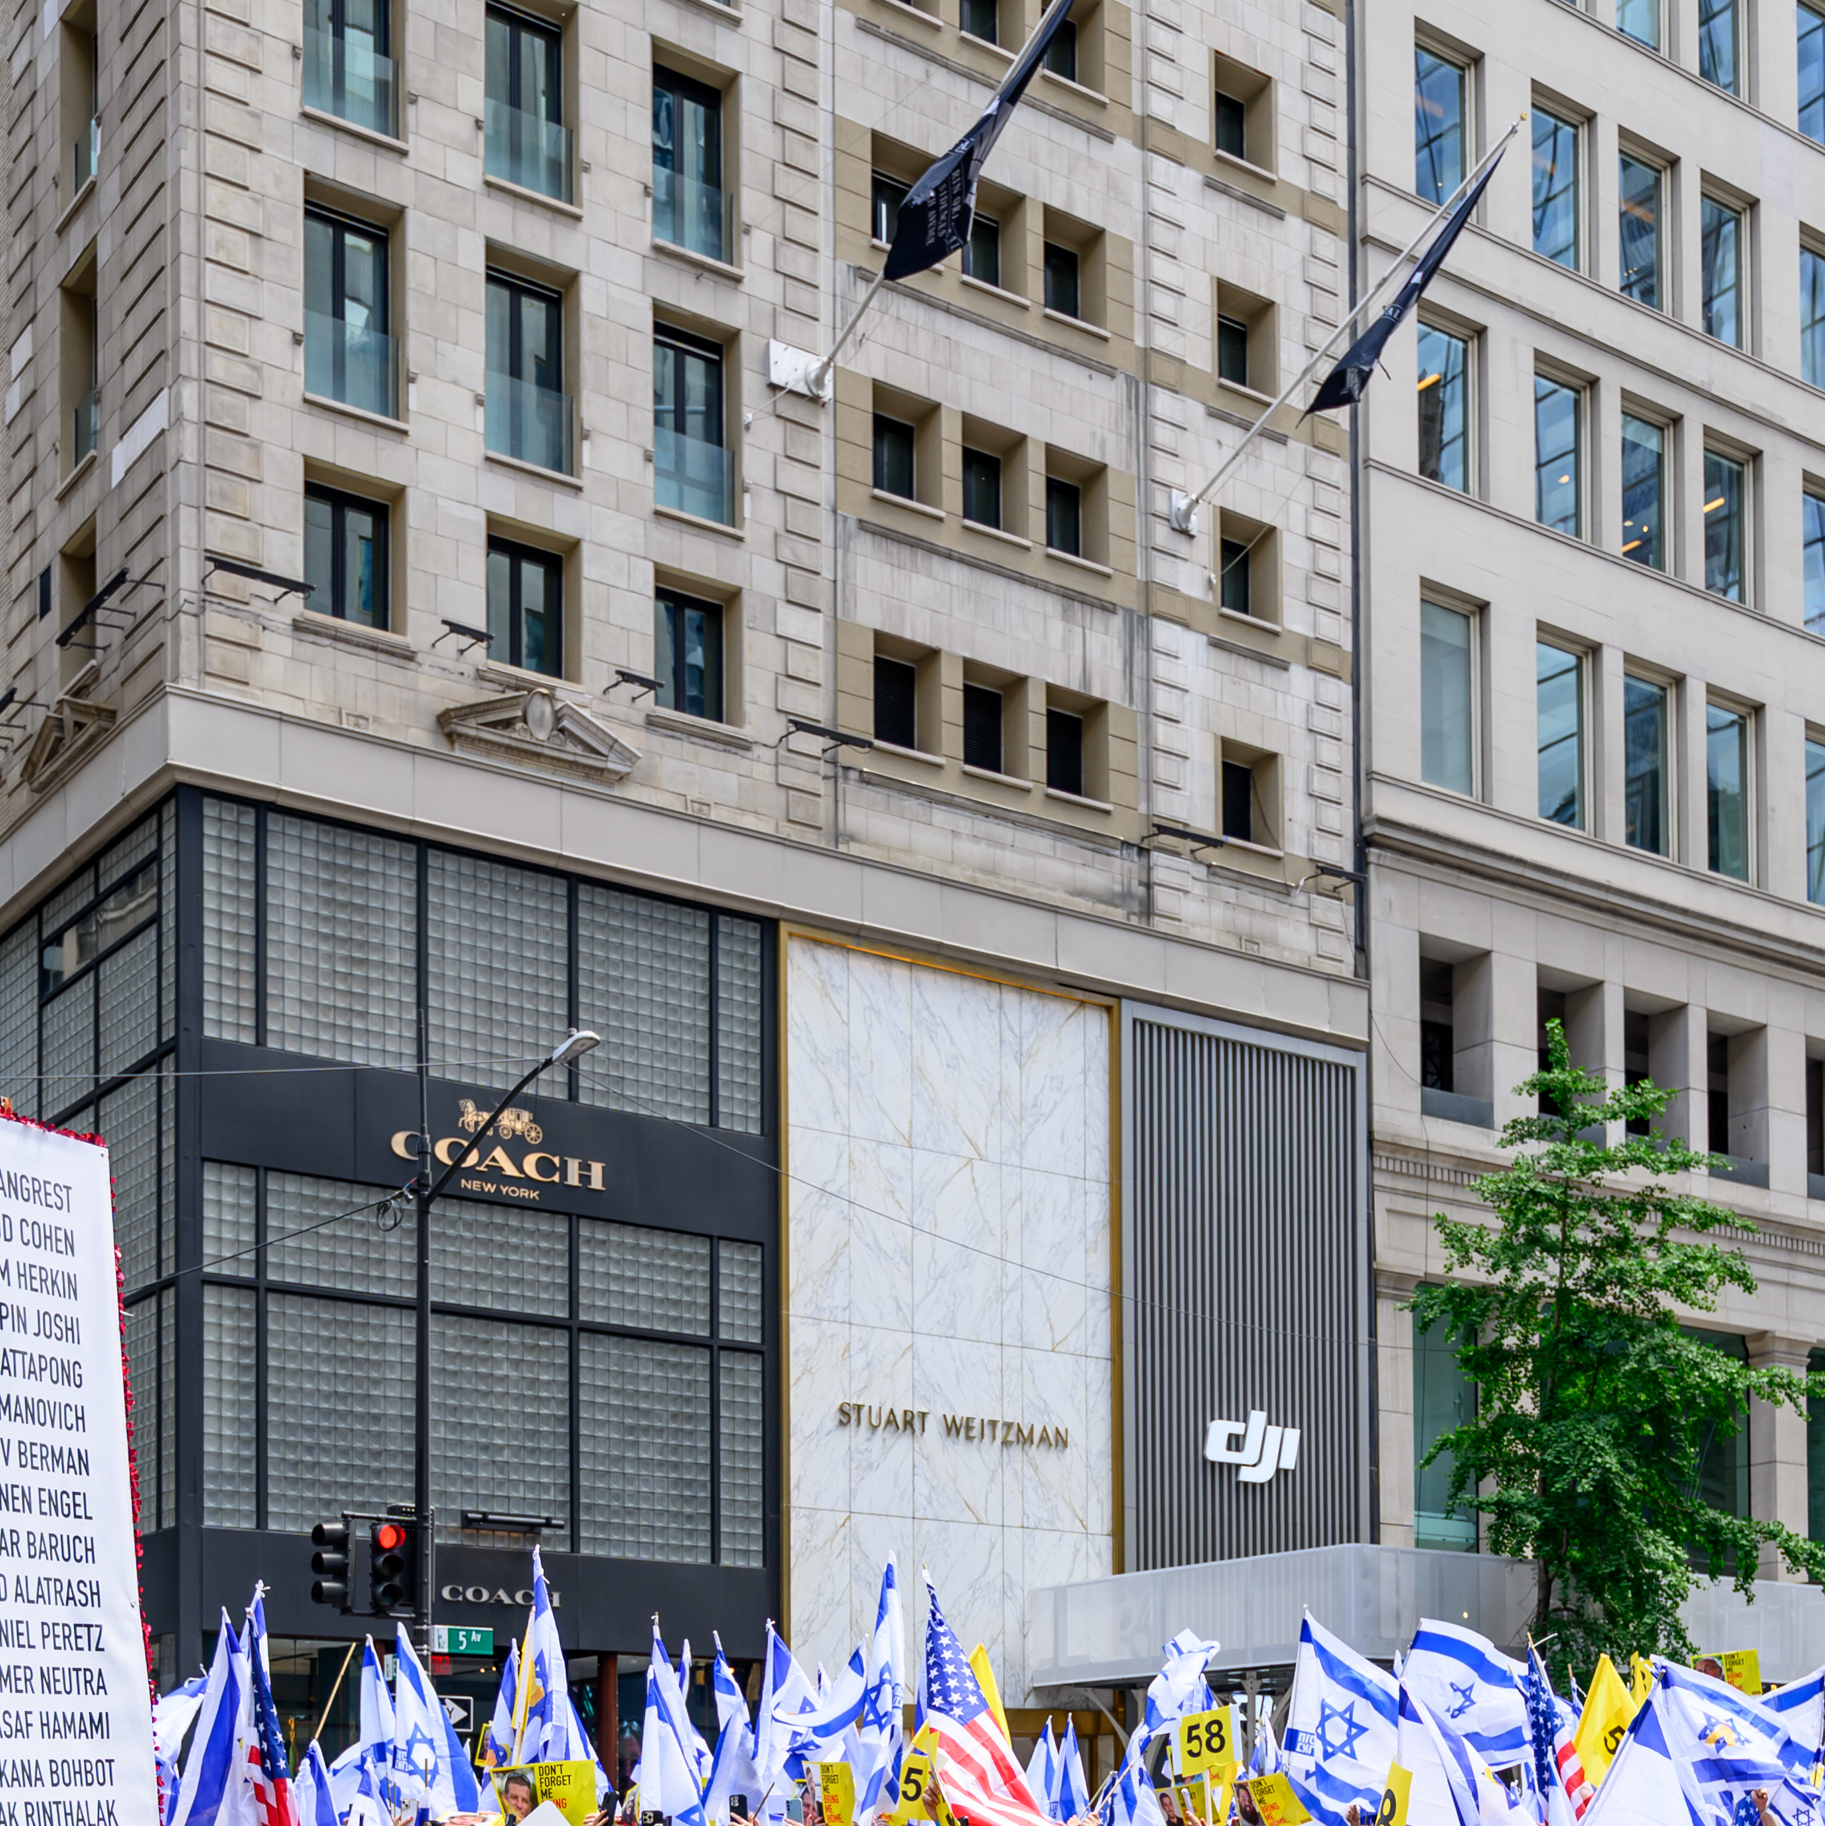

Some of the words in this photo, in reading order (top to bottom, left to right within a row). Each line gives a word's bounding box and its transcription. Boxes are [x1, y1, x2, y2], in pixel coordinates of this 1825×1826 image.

[390, 1130, 607, 1191] COACH
[460, 1178, 498, 1194] NEW
[500, 1184, 540, 1200] YORK
[31, 1309, 81, 1347] JOSHI
[838, 1401, 930, 1434] STUART
[942, 1413, 1070, 1450] WEITZMAN
[26, 1530, 95, 1563] BARUCH
[458, 1631, 467, 1651] 5
[471, 1631, 482, 1642] Av
[1186, 1719, 1226, 1759] 58
[49, 1759, 116, 1786] BOHBOT
[538, 1764, 564, 1777] DON'T
[539, 1774, 572, 1788] FORGET
[822, 1774, 839, 1784] FORGET
[1250, 1778, 1268, 1789] DON'T
[540, 1787, 553, 1799] ME
[1253, 1784, 1276, 1798] FORGET
[824, 1794, 839, 1804] BRING
[1256, 1796, 1267, 1805] ME
[1261, 1801, 1280, 1815] BRING
[1265, 1812, 1276, 1822] ME
